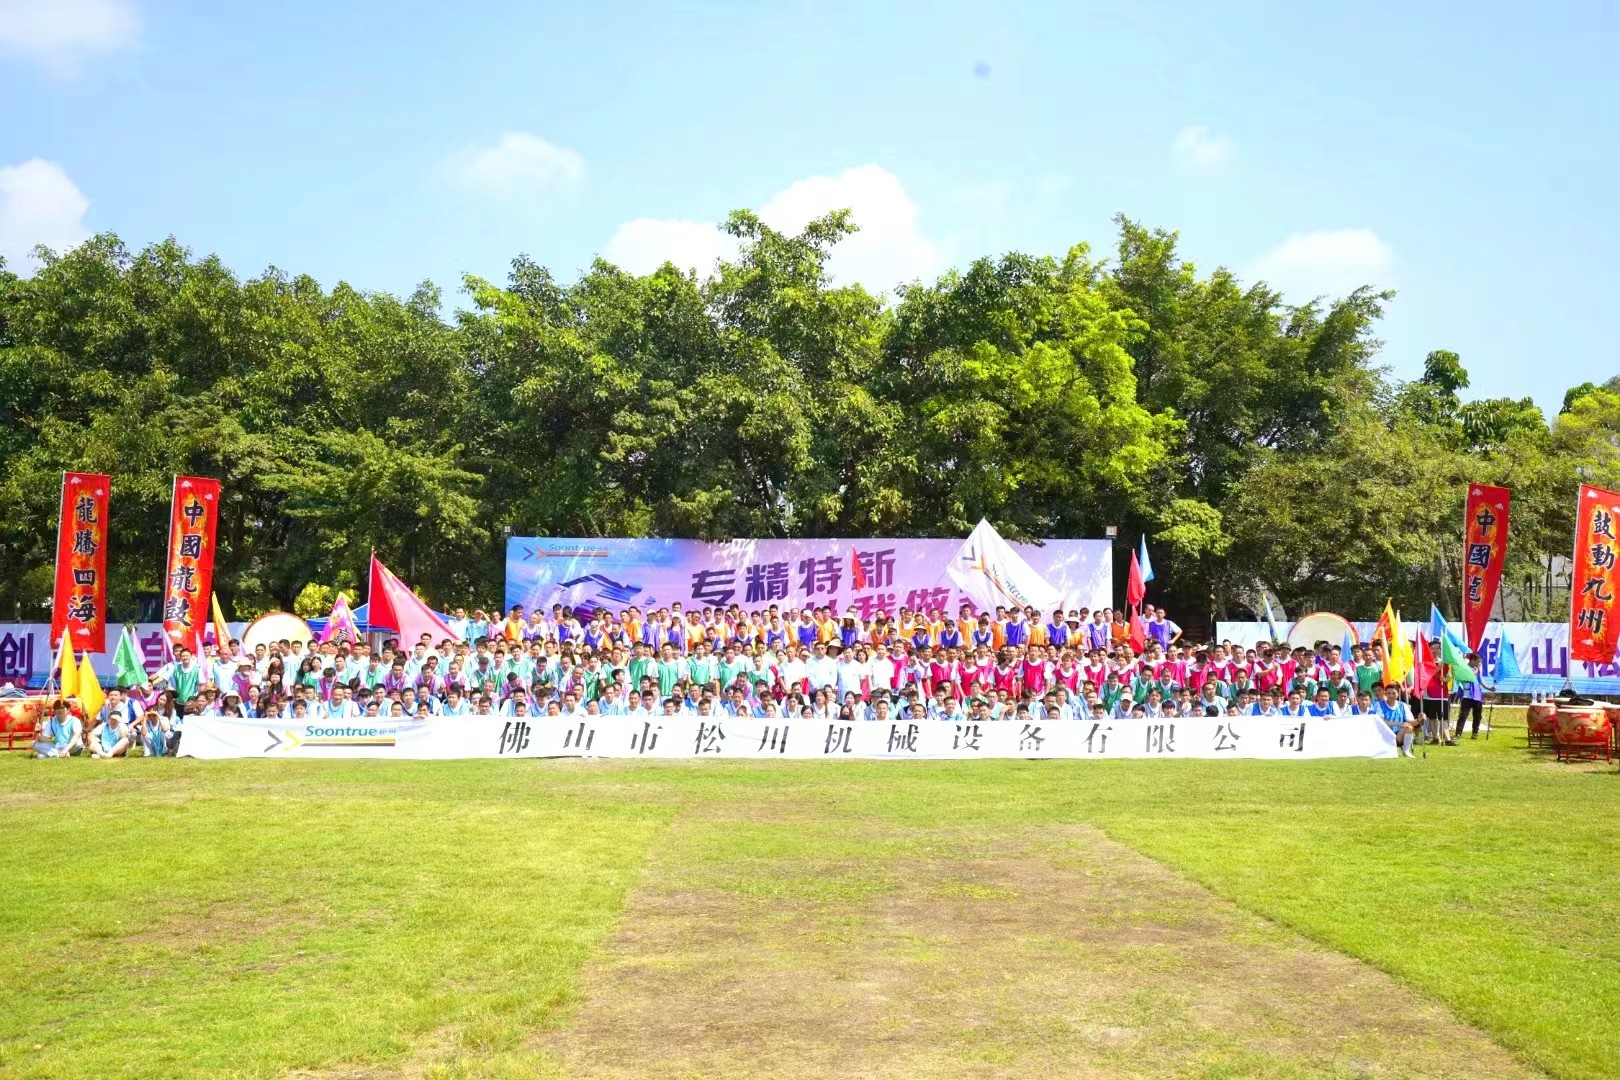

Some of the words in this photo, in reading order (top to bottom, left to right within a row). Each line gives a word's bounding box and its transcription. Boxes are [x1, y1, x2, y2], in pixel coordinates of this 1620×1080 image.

[67, 497, 98, 622] 龍騰四海
[165, 500, 205, 627] 中國龍鼓
[691, 548, 896, 606] 专精特新
[991, 563, 1029, 604] Sontrue
[1577, 510, 1616, 634] 鼓動九州
[305, 725, 378, 737] Soontrue
[497, 721, 1306, 755] 佛山市松川机械设备有限公司
